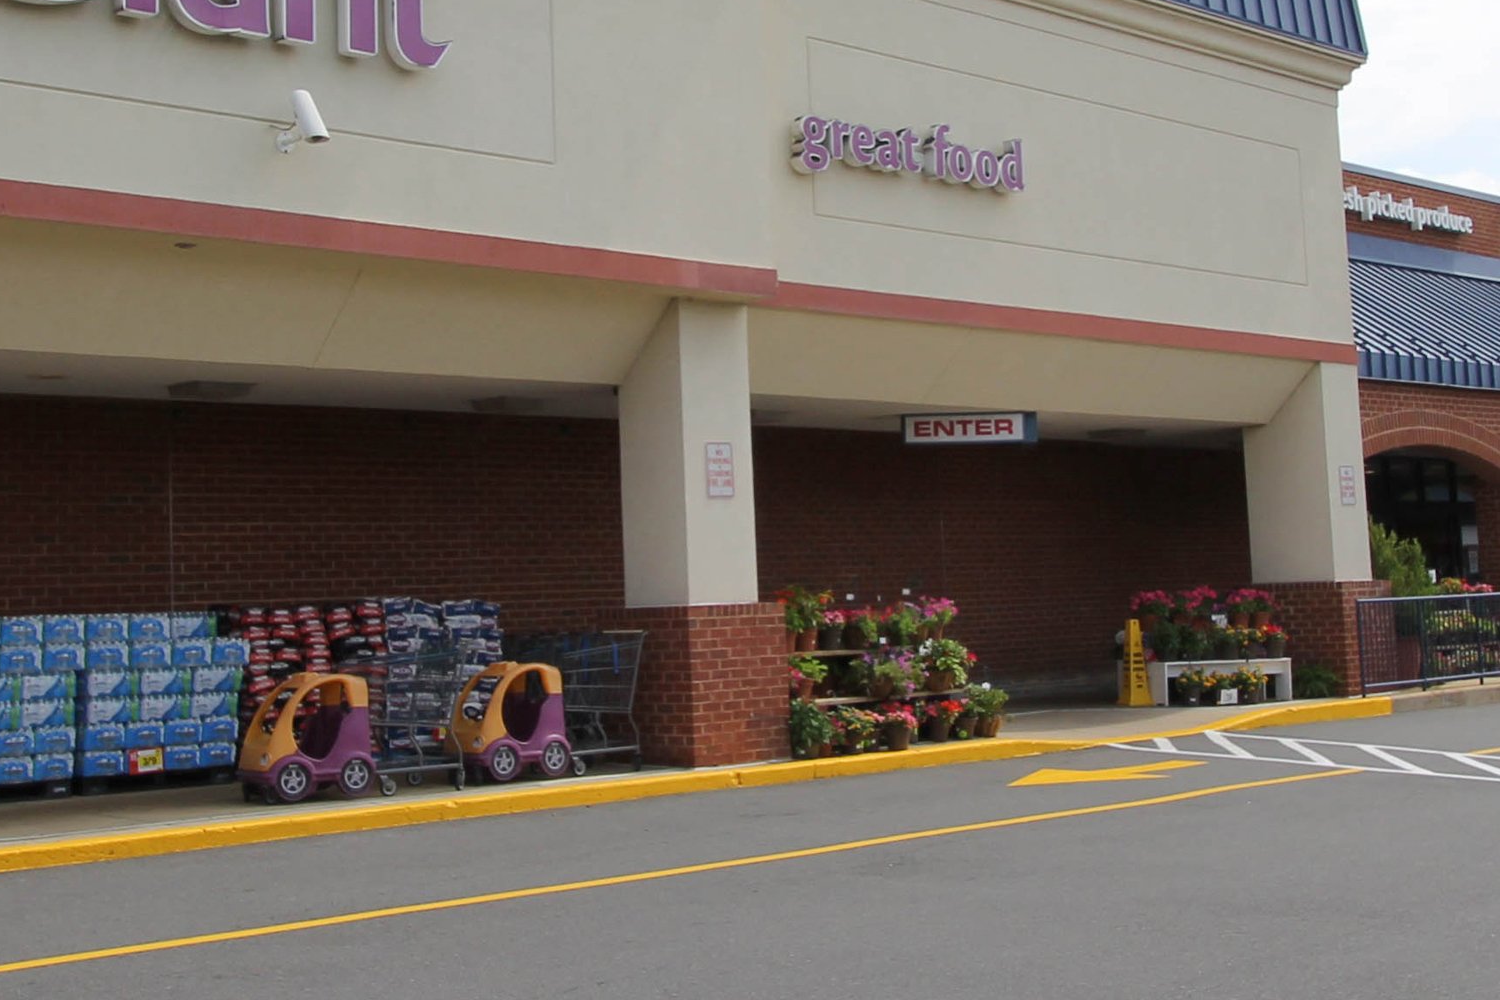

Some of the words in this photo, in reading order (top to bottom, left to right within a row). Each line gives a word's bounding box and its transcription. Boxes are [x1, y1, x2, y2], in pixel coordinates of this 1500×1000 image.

[791, 116, 921, 174] great
[923, 123, 1025, 193] food
[1362, 190, 1413, 222] picked
[1412, 203, 1473, 234] produce
[913, 418, 1014, 438] ENTER
